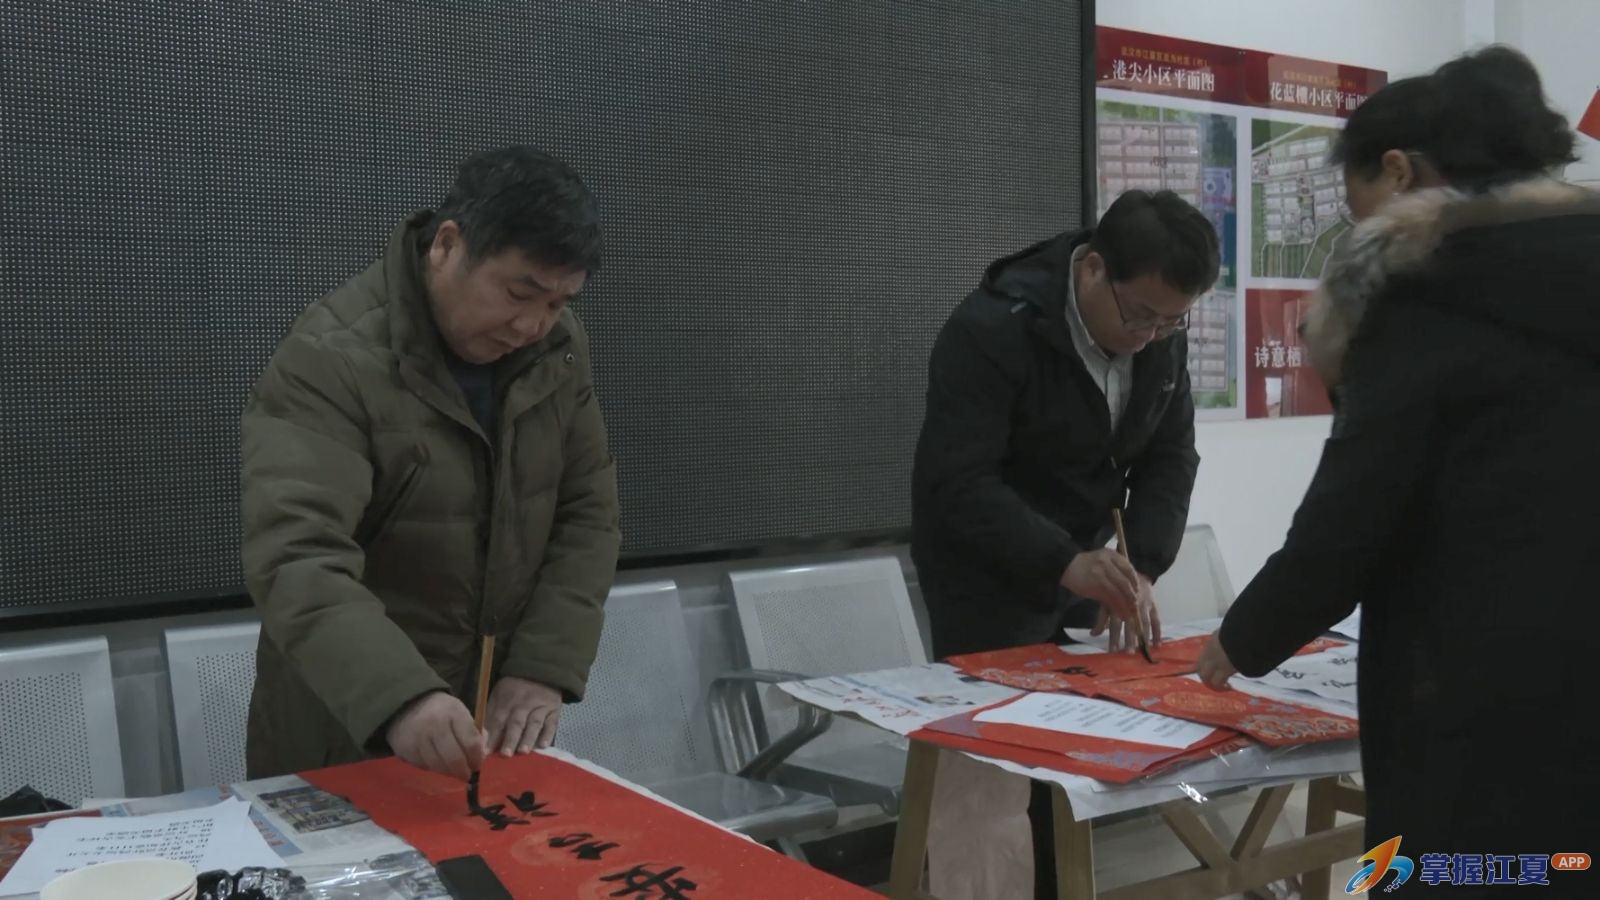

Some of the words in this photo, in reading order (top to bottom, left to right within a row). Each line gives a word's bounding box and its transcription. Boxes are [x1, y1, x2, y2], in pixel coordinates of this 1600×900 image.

[1112, 59, 1215, 92] 港尖小区平面图
